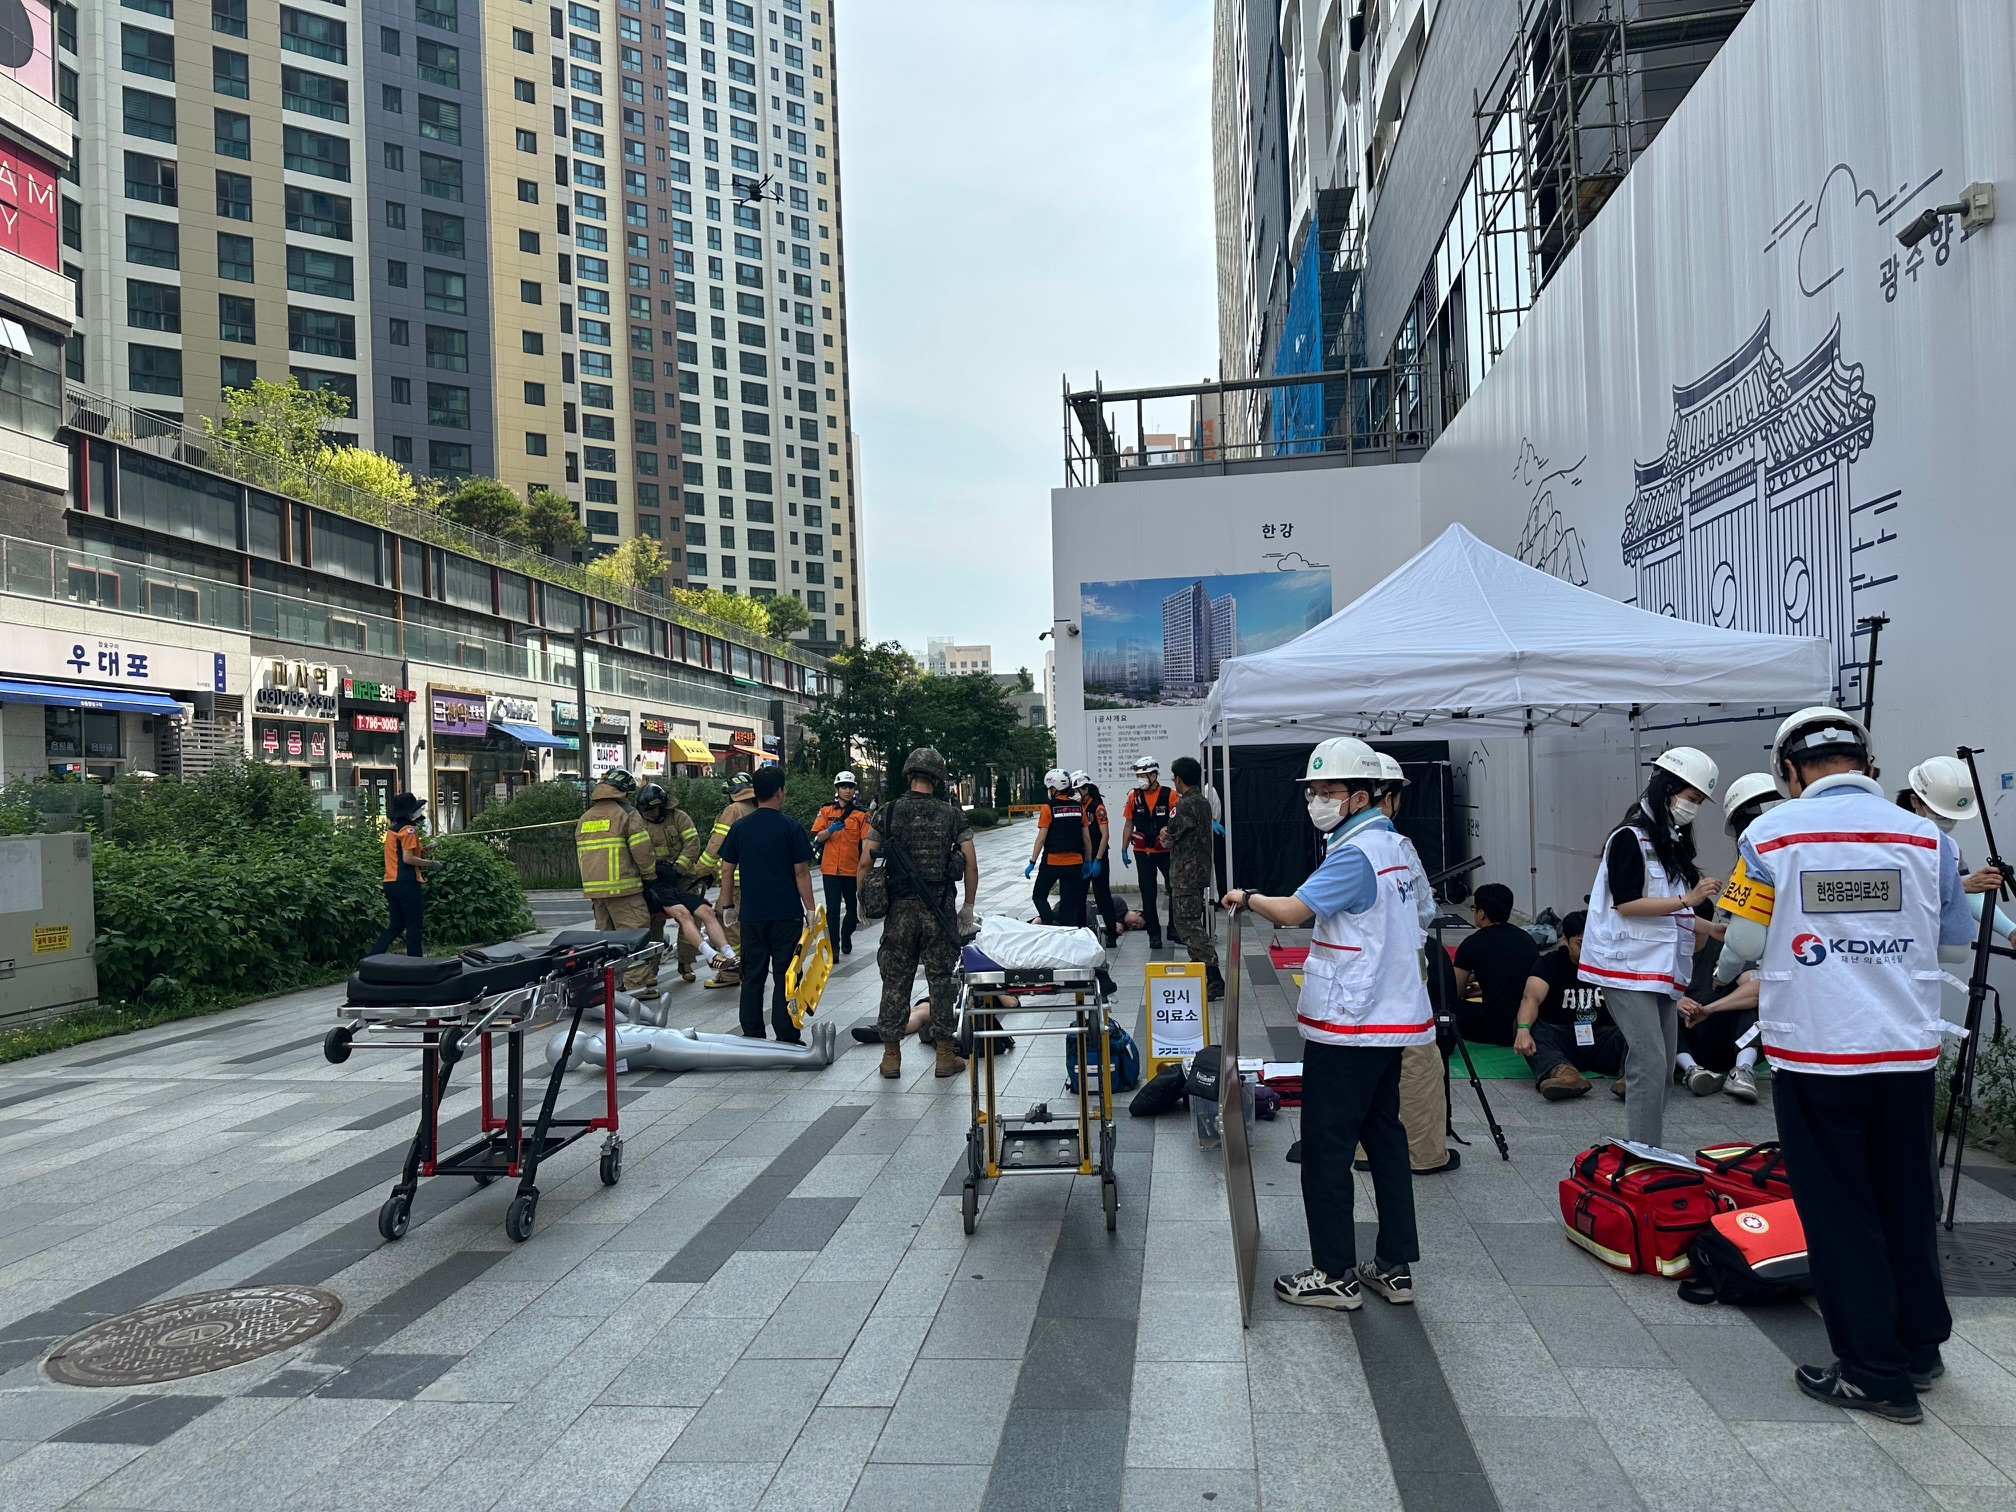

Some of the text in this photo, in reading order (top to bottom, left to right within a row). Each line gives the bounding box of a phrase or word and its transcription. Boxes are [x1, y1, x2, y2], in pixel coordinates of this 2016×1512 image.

[1879, 212, 1983, 303] 광주향
[66, 644, 149, 678] 우대포
[263, 728, 326, 756] 부동산
[1816, 880, 1890, 902] 현장응급의료소장
[1828, 938, 1914, 955] KDMAT
[1162, 989, 1190, 1004] 임시
[1156, 1009, 1199, 1024] 의료소
